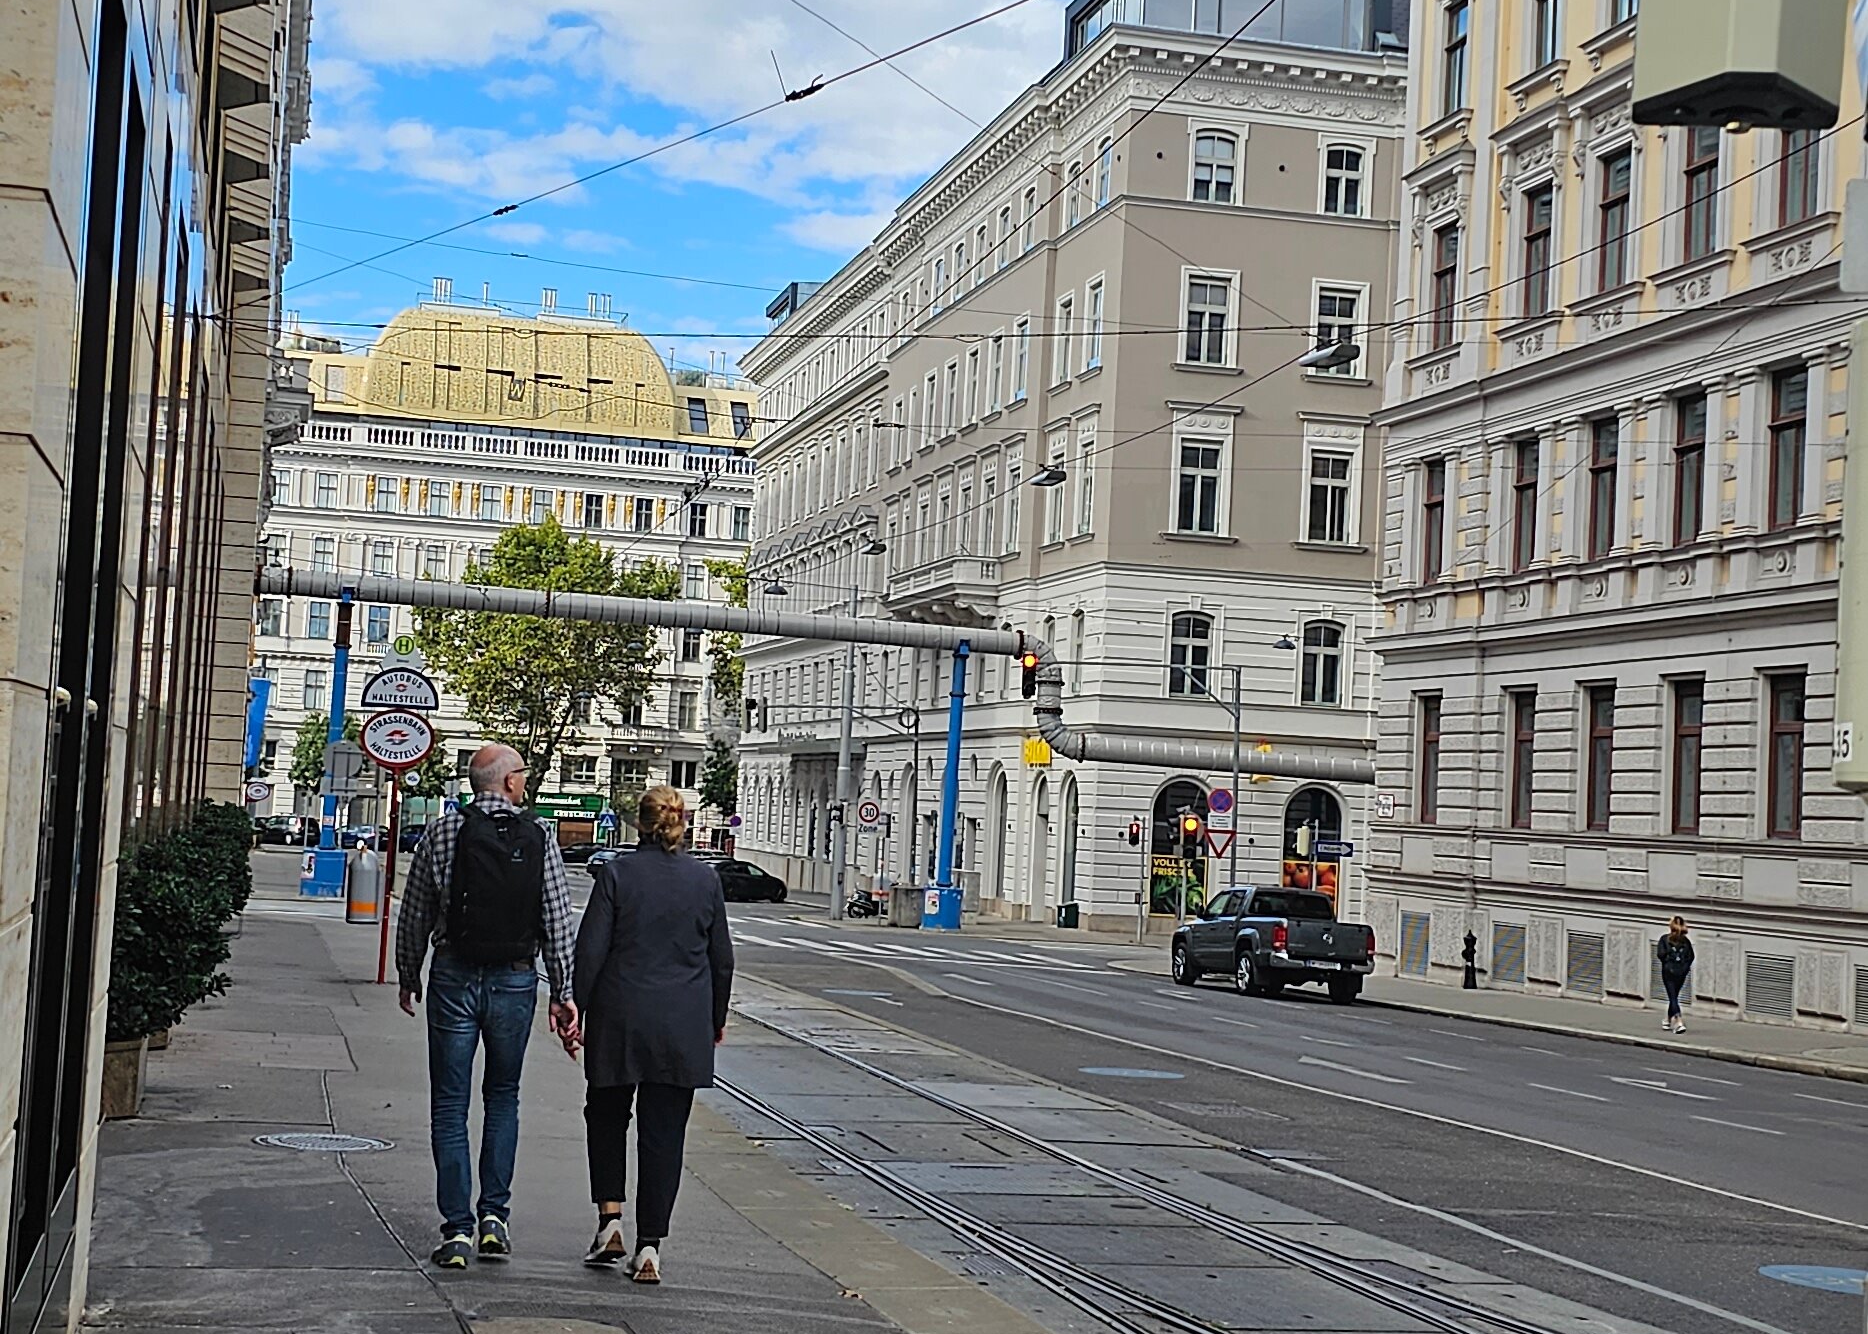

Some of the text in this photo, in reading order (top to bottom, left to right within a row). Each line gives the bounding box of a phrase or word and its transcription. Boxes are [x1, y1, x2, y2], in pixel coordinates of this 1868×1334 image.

[398, 639, 410, 652] H
[381, 673, 424, 689] AUTOBUS
[371, 693, 430, 705] HALTESTELLE
[369, 715, 427, 737] STRASSENBAHN
[369, 741, 423, 760] HALTESTELLE
[864, 807, 875, 818] 30
[858, 823, 878, 833] Zone
